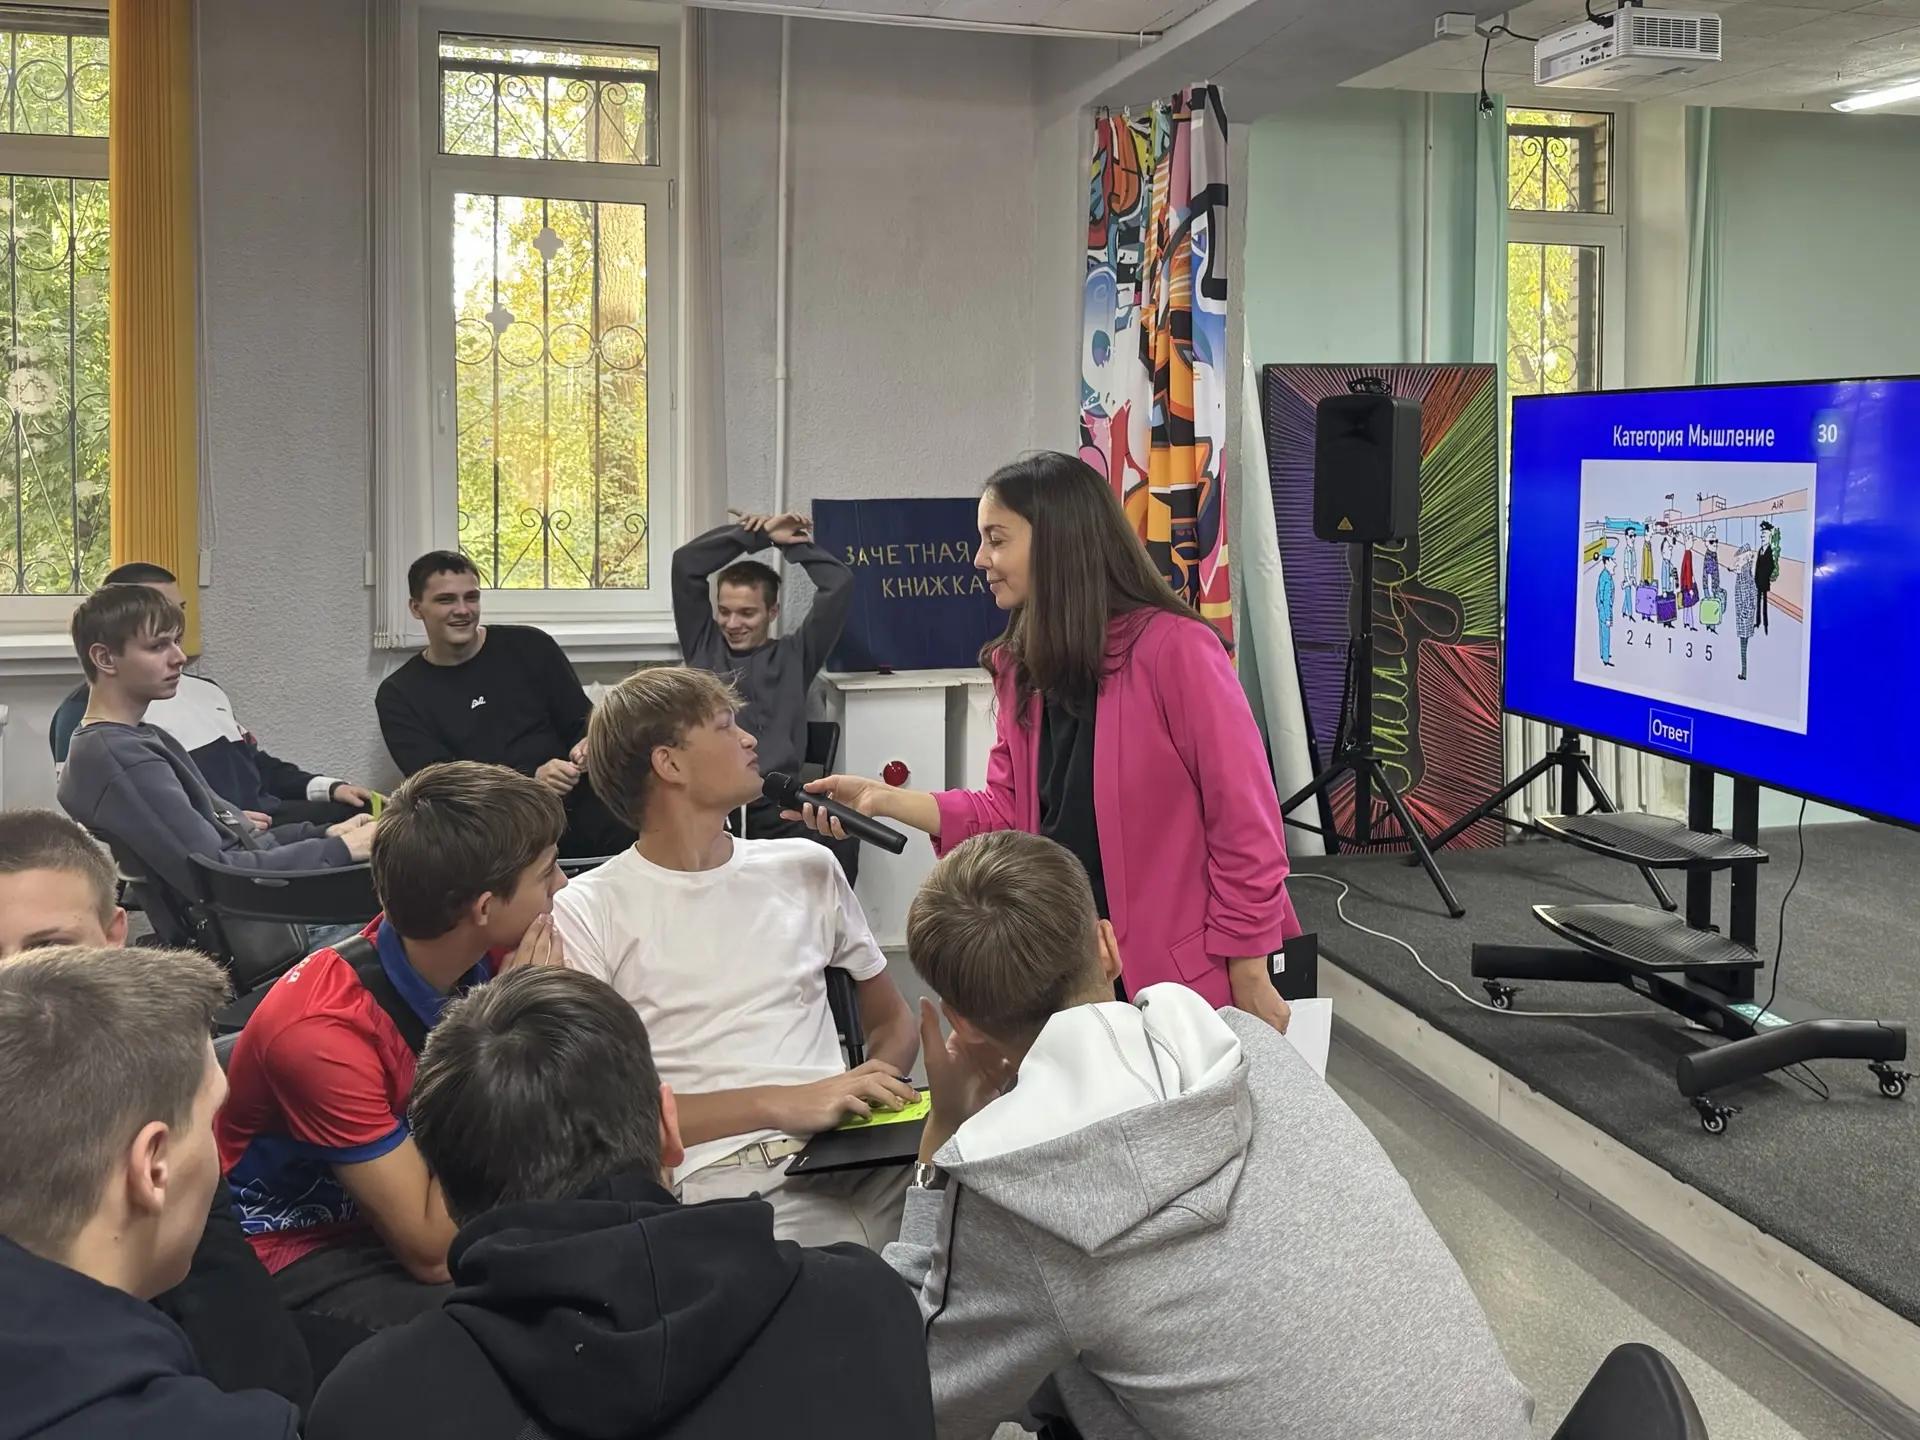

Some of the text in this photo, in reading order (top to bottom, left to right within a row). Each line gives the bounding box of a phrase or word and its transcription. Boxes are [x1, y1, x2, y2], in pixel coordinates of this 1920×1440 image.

[1612, 423, 1775, 452] Категория Мышление
[1817, 424, 1838, 443] 30
[1771, 499, 1784, 511] AIR
[845, 540, 970, 566] ЗАЧЕТНАЯ
[882, 575, 986, 598] КНИЖКА
[1626, 629, 1713, 661] 2 4 1 3 5
[1652, 719, 1690, 744] Ответ
